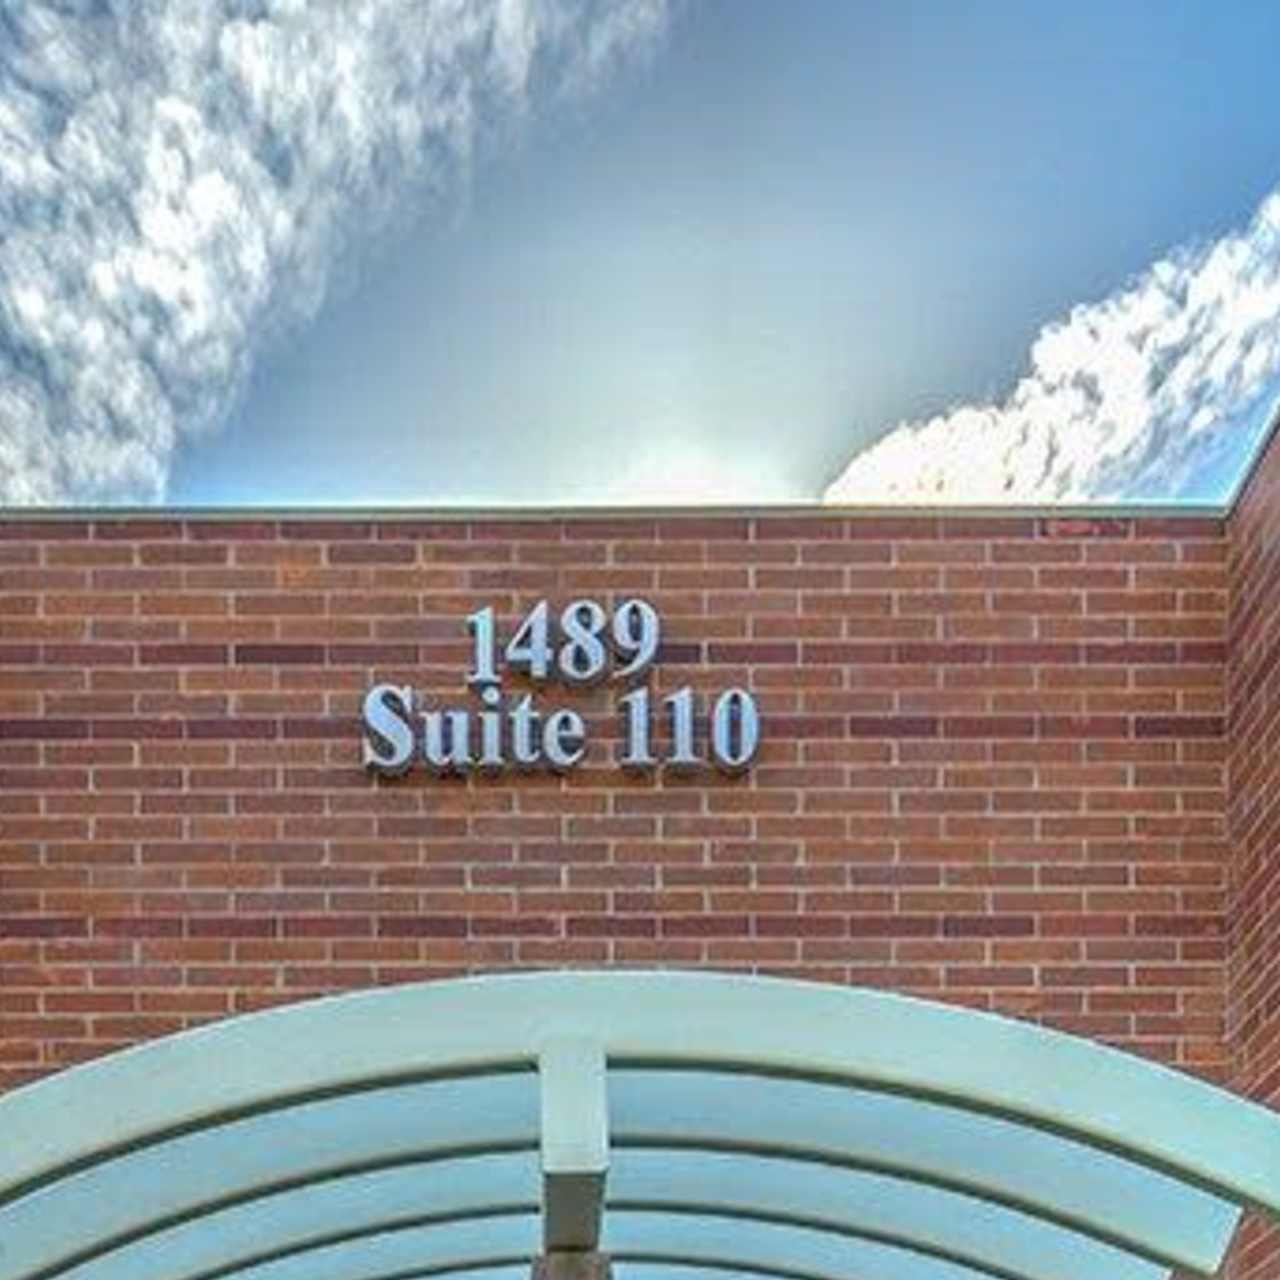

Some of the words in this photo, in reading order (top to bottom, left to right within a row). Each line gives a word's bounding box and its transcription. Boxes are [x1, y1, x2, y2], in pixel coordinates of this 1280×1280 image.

[465, 598, 662, 684] 1489
[362, 683, 586, 768] Suite
[618, 685, 760, 768] 110
